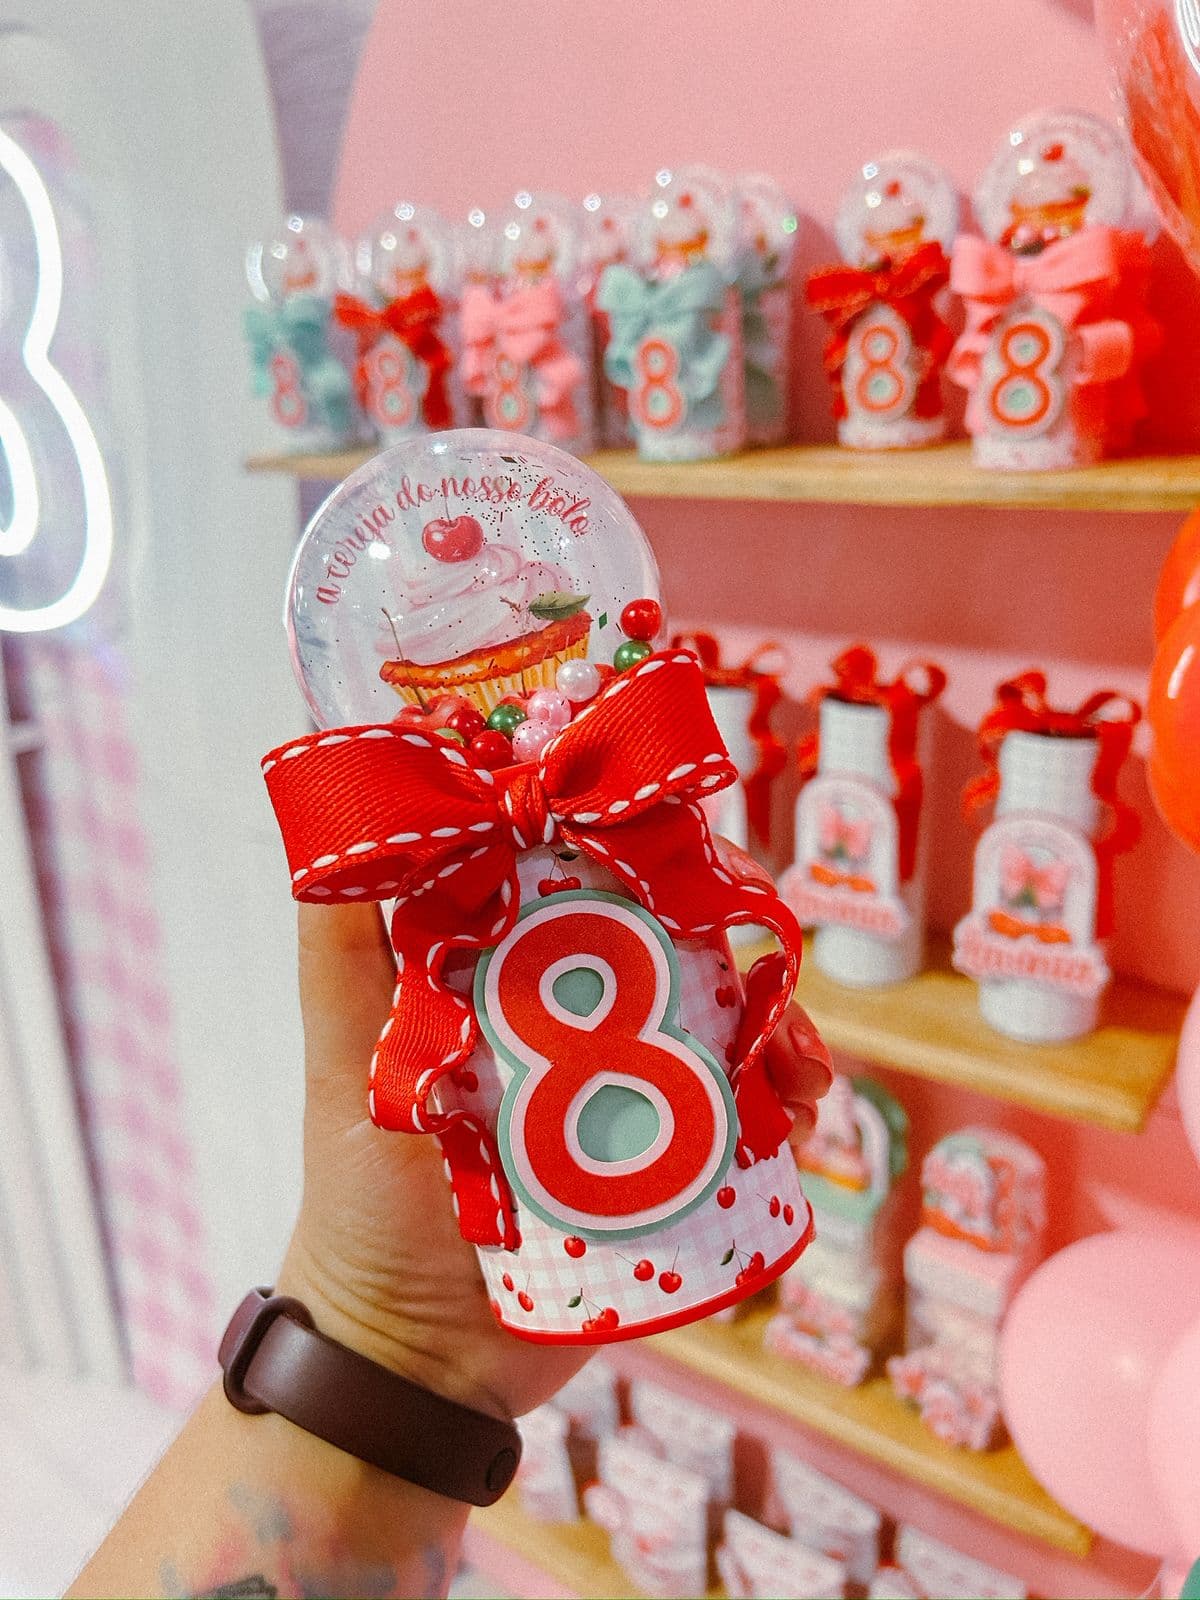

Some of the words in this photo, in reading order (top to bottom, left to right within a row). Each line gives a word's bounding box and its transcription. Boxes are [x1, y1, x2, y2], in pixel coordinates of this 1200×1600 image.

[635, 337, 683, 429] 8
[859, 325, 905, 411] 8
[992, 323, 1050, 426] 8
[396, 475, 437, 512] do
[440, 474, 523, 504] nosso
[527, 475, 590, 538] bolo
[326, 505, 396, 578] cereja
[316, 583, 341, 605] a
[489, 904, 724, 1226] 8
